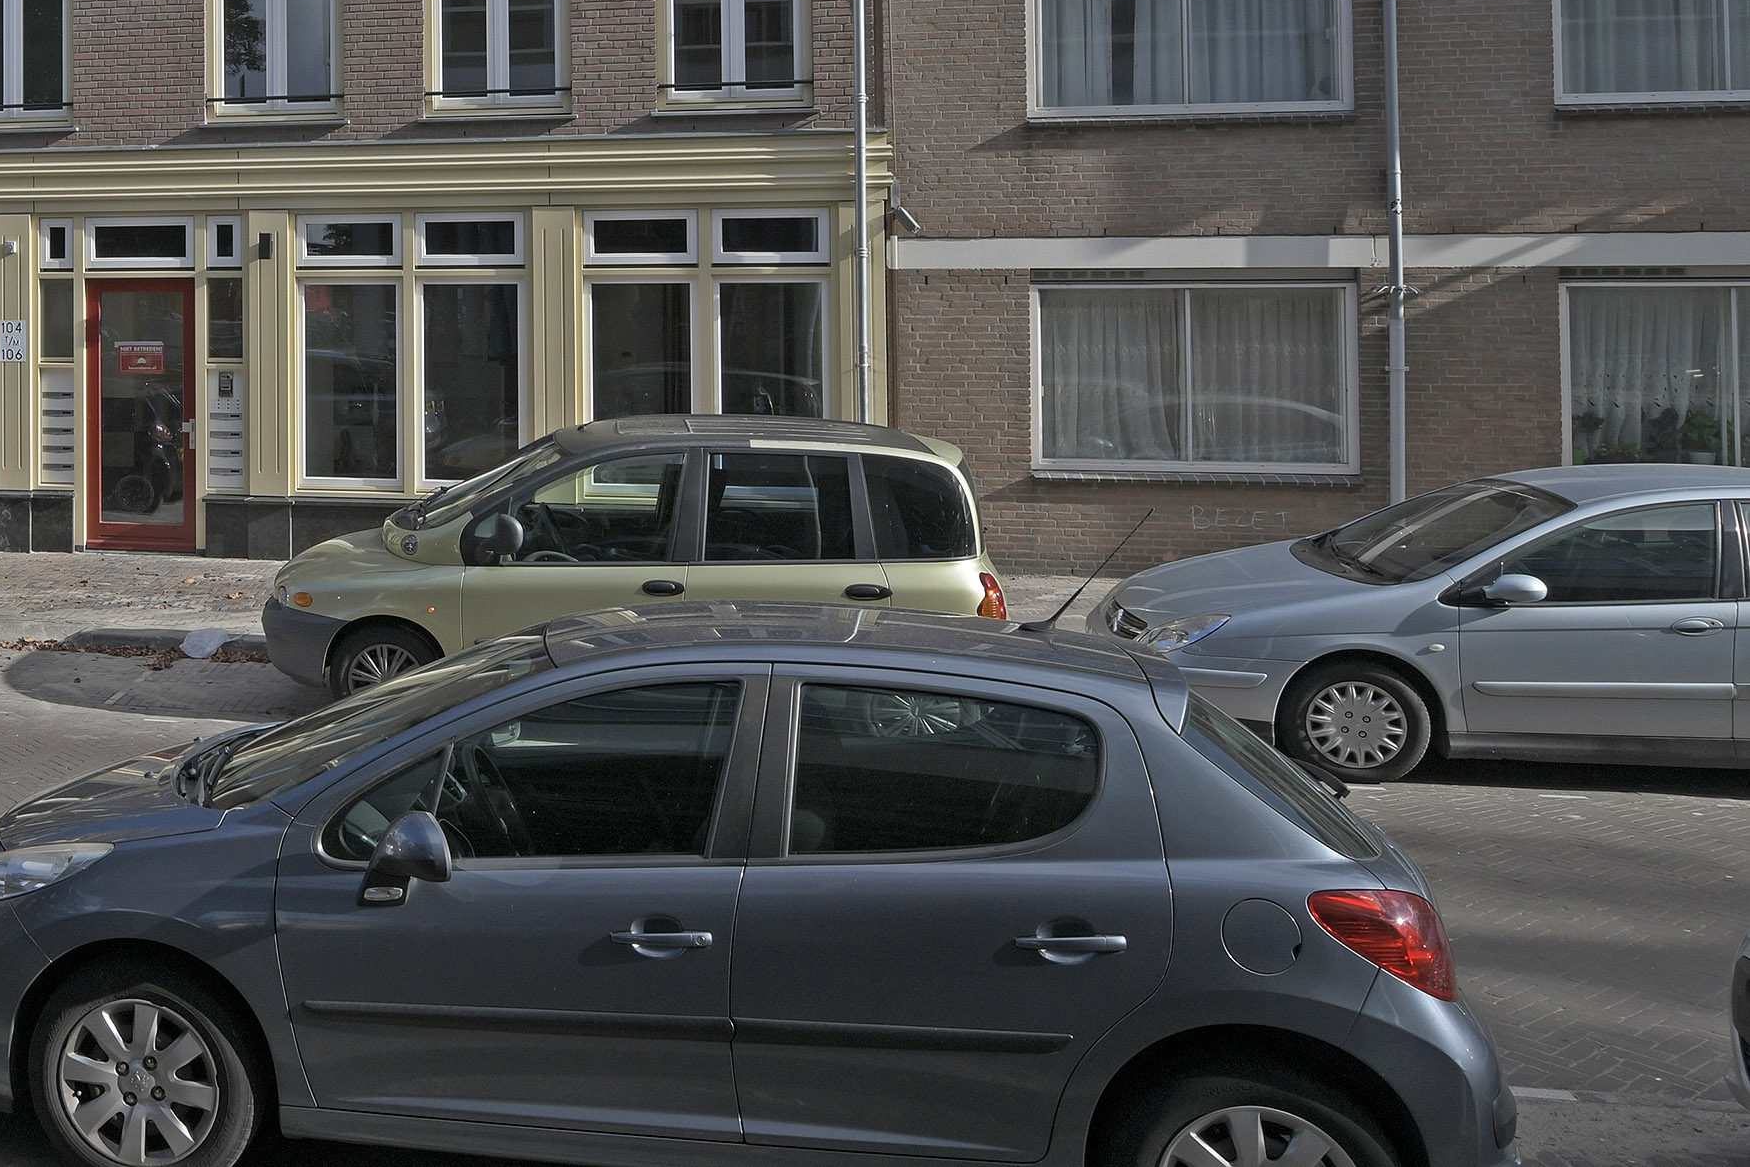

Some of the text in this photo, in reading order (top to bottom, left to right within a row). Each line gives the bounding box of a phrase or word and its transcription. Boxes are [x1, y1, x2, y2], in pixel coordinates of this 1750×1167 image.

[1, 322, 22, 333] 104
[5, 336, 19, 346] T/M
[2, 349, 23, 360] 106
[1191, 505, 1290, 530] BEZET
